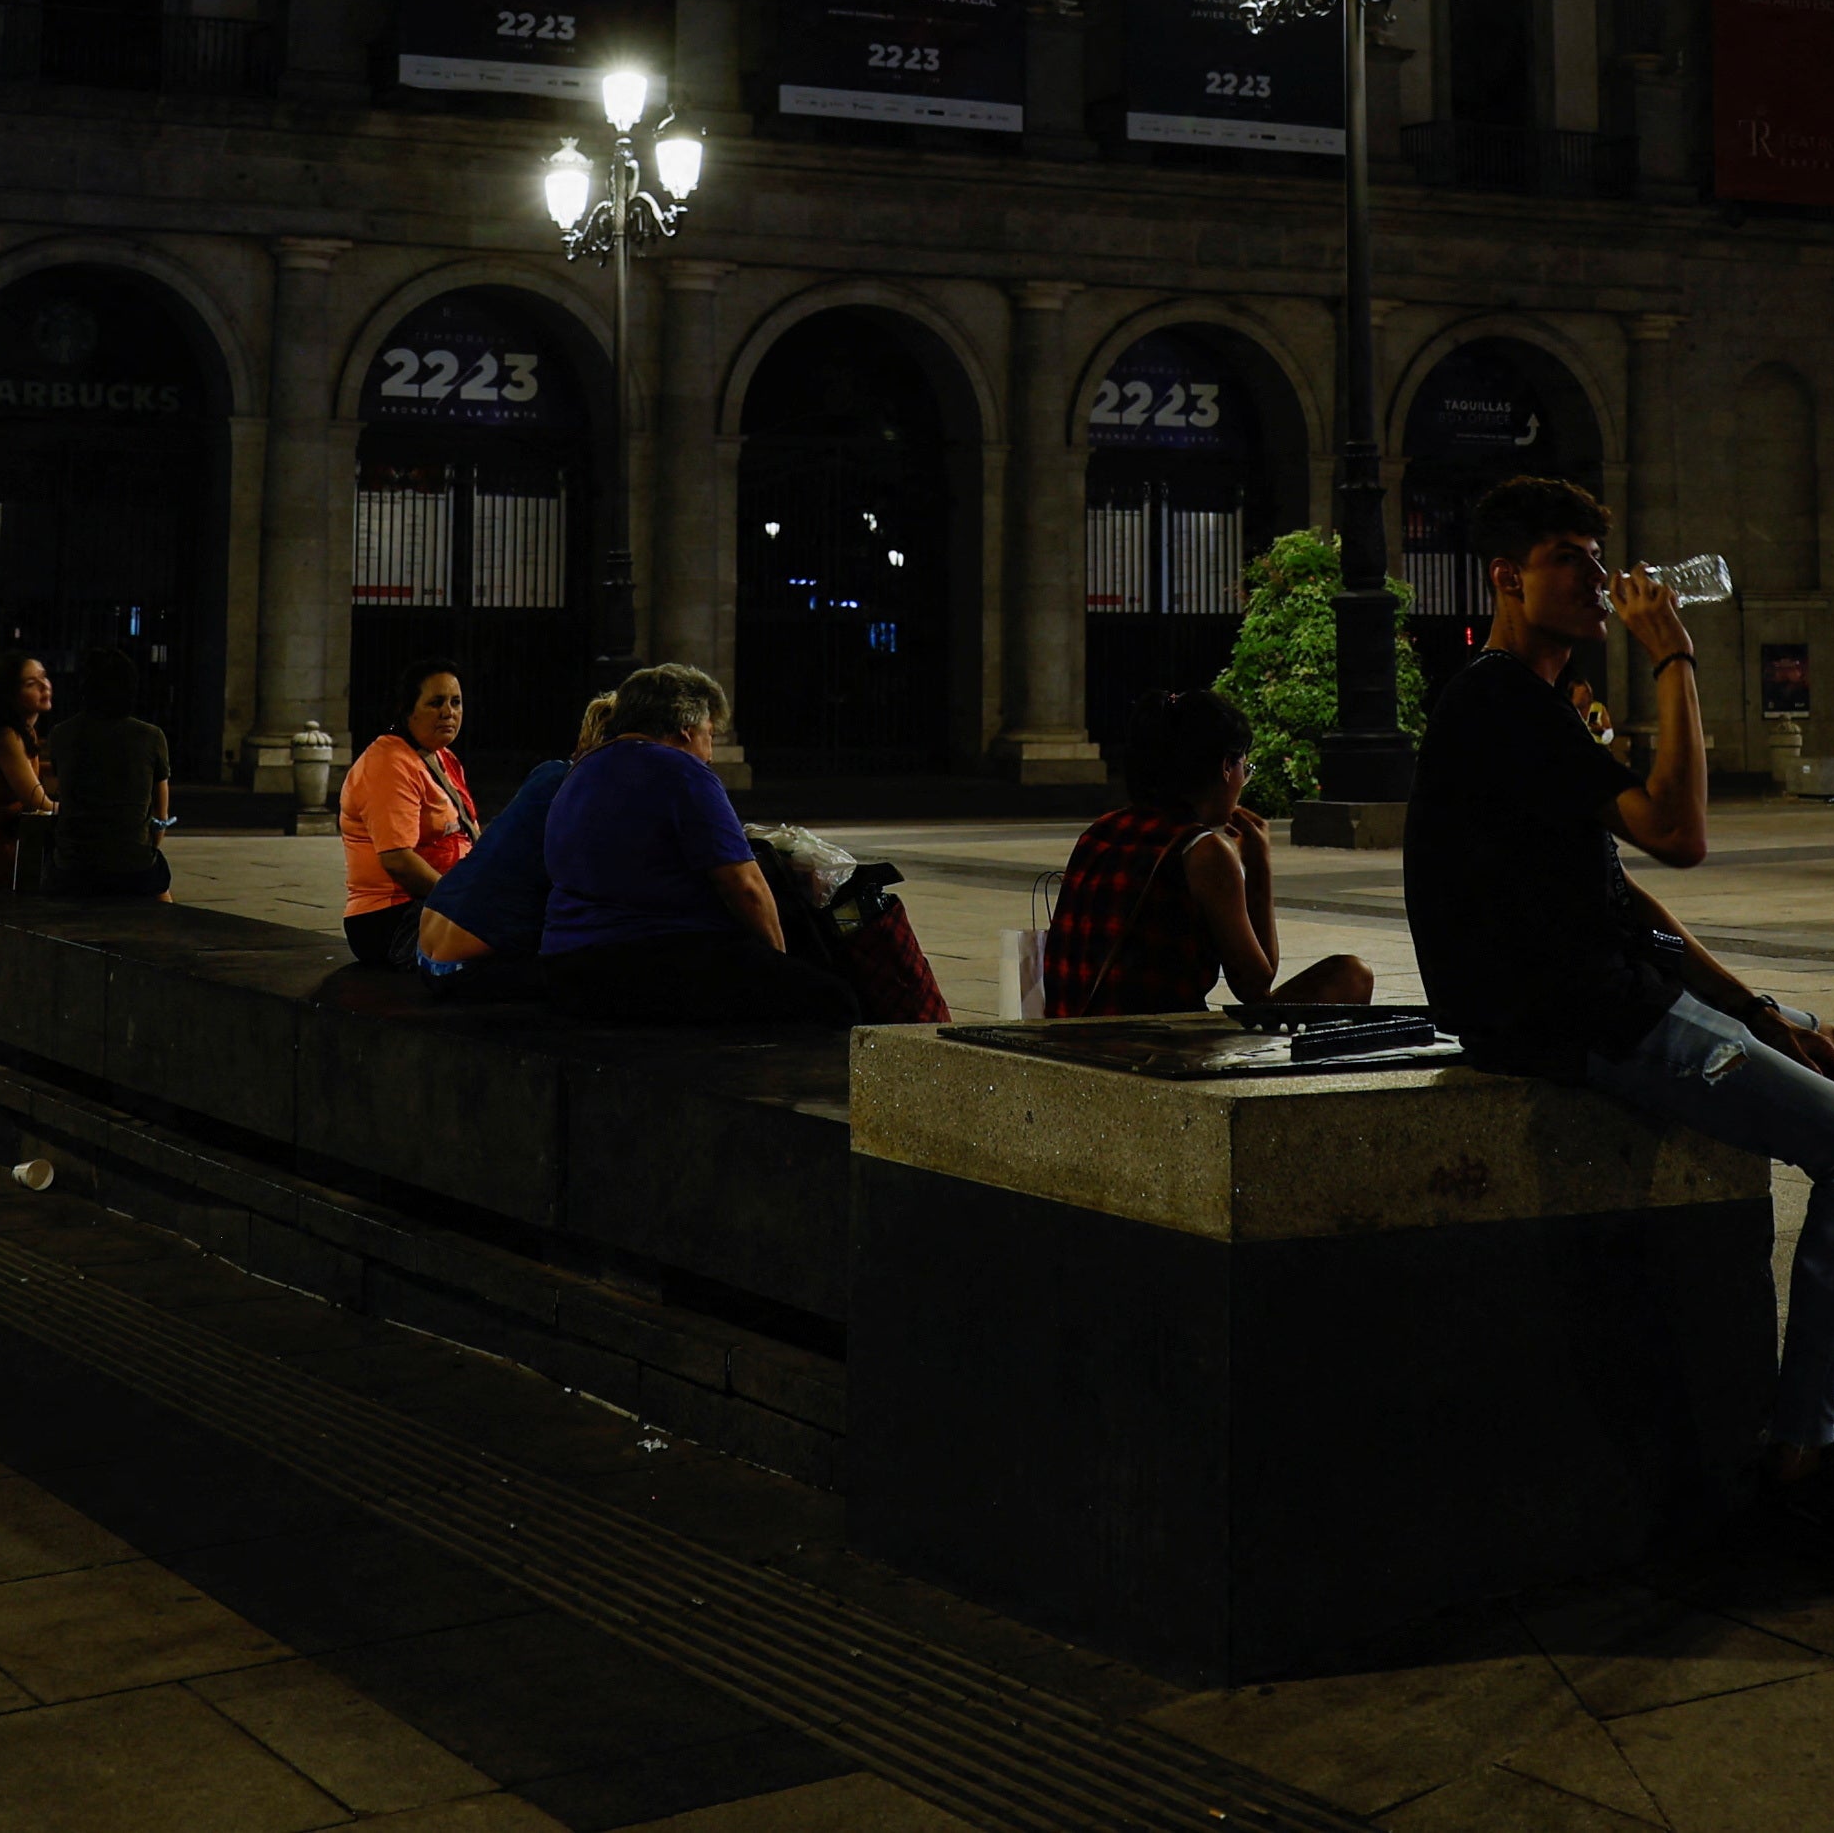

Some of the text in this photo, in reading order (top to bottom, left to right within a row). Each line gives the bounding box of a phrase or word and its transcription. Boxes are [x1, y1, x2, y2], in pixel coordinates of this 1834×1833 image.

[1191, 11, 1226, 20] JAVIER
[381, 406, 438, 416] ABONOS
[467, 409, 484, 418] LA
[495, 410, 538, 419] VENTA
[1444, 399, 1512, 413] TAQUILLAS
[1438, 412, 1511, 425] BOX OFFICE
[1160, 434, 1174, 442] LA
[1184, 434, 1219, 443] VENTA
